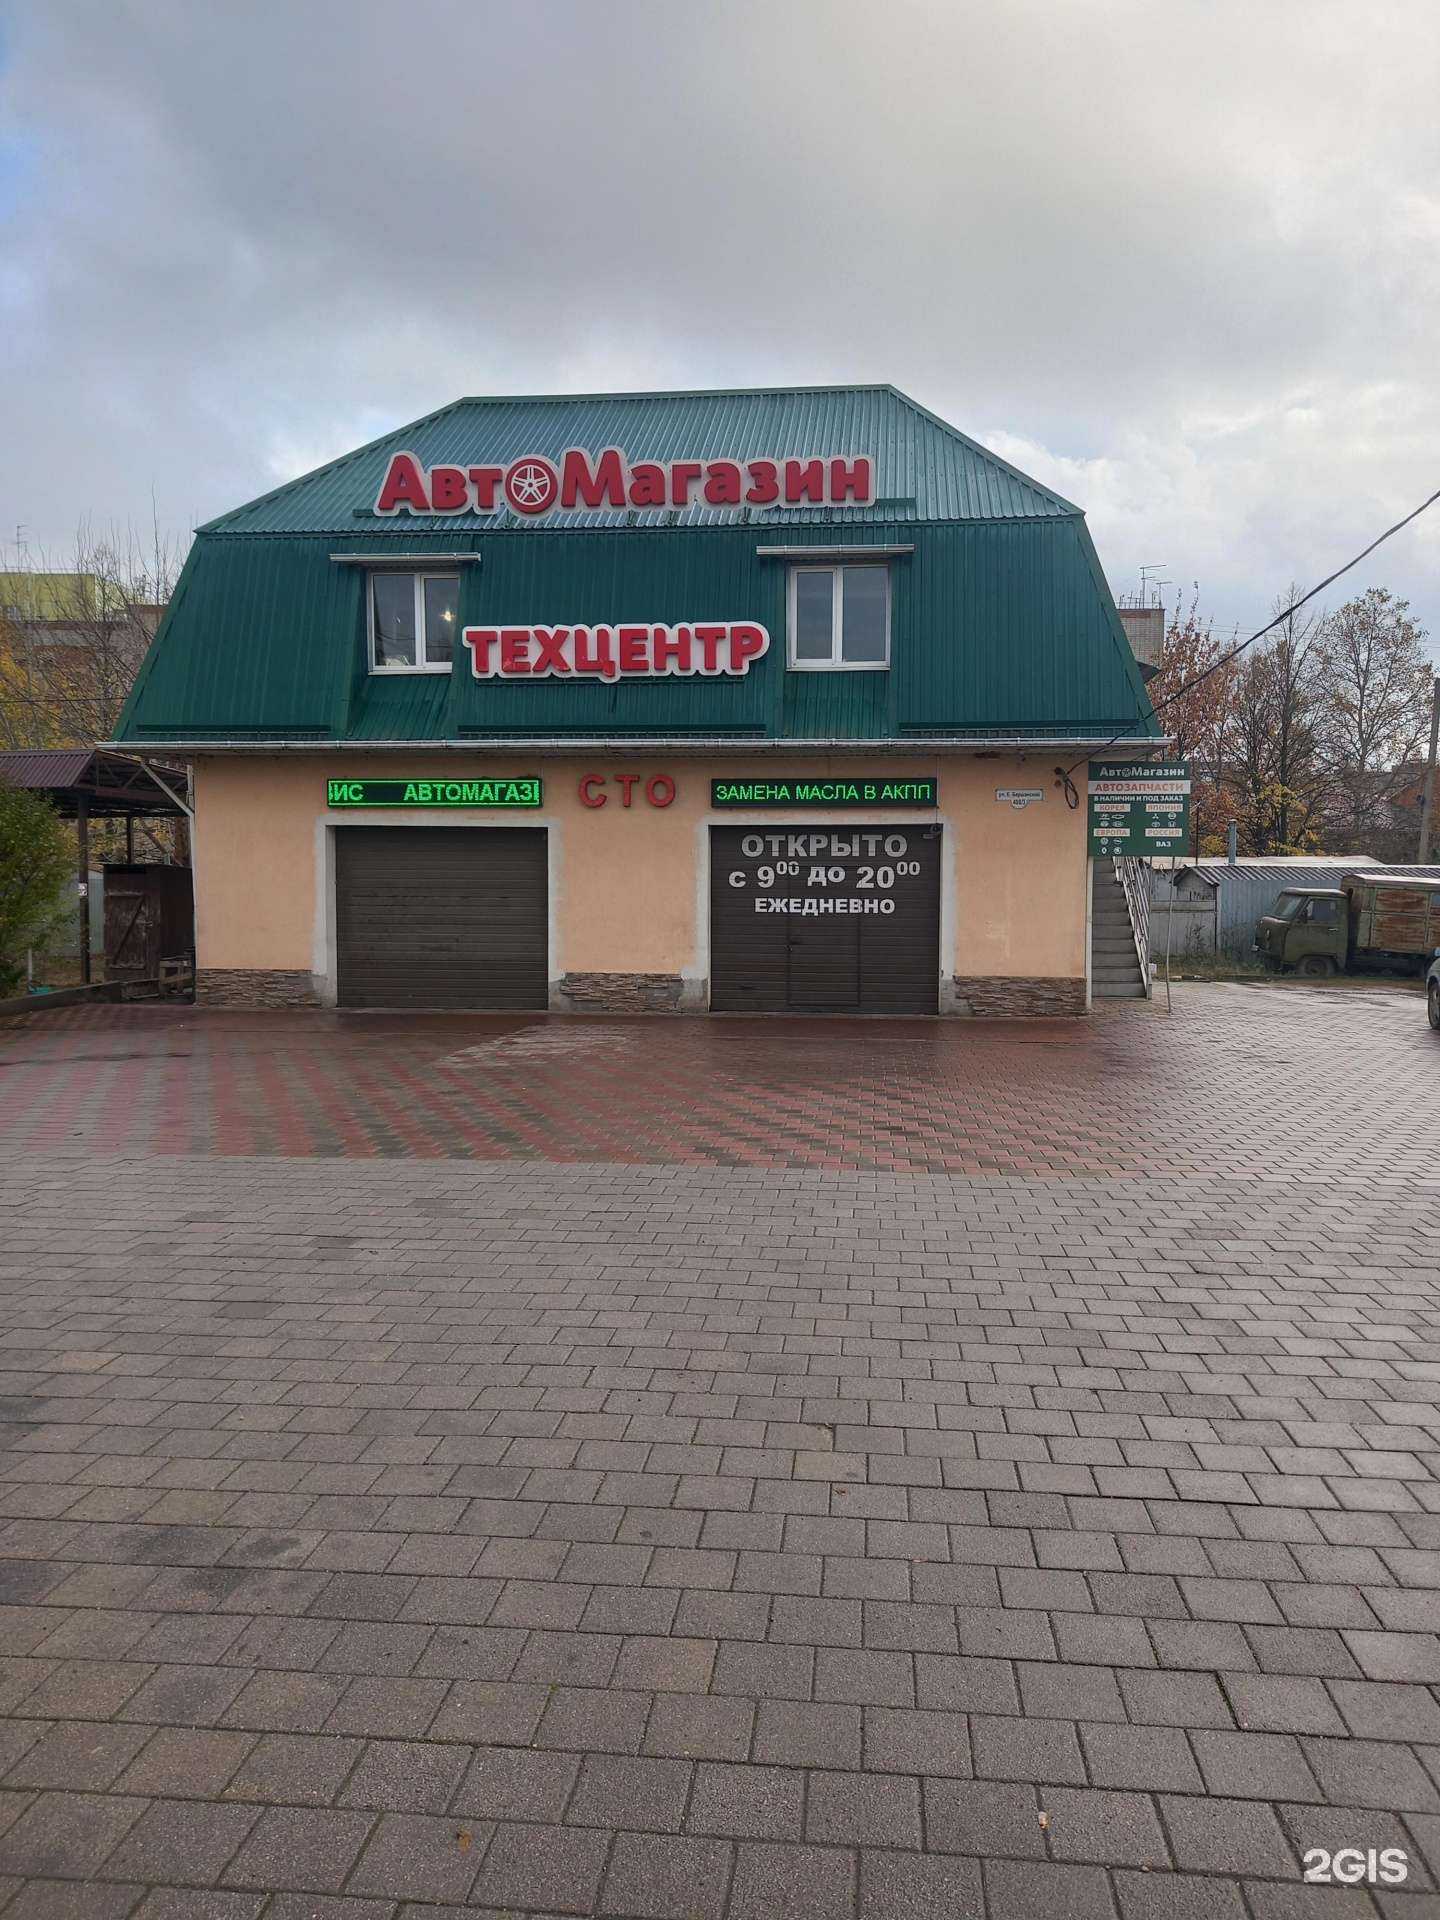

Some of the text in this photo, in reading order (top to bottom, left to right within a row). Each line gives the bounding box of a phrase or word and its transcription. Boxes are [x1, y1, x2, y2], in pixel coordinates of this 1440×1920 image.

[464, 625, 765, 679] ТЕХЦЕНТР
[577, 773, 676, 808] СТО
[716, 784, 931, 800] ЗАМЕНА МАСЛА В АКПП
[1095, 783, 1184, 792] АВТОЗАПЧАСТИ
[741, 834, 908, 858] ОТКРЫТО
[754, 898, 896, 916] ЕЖЕДНЕВНО
